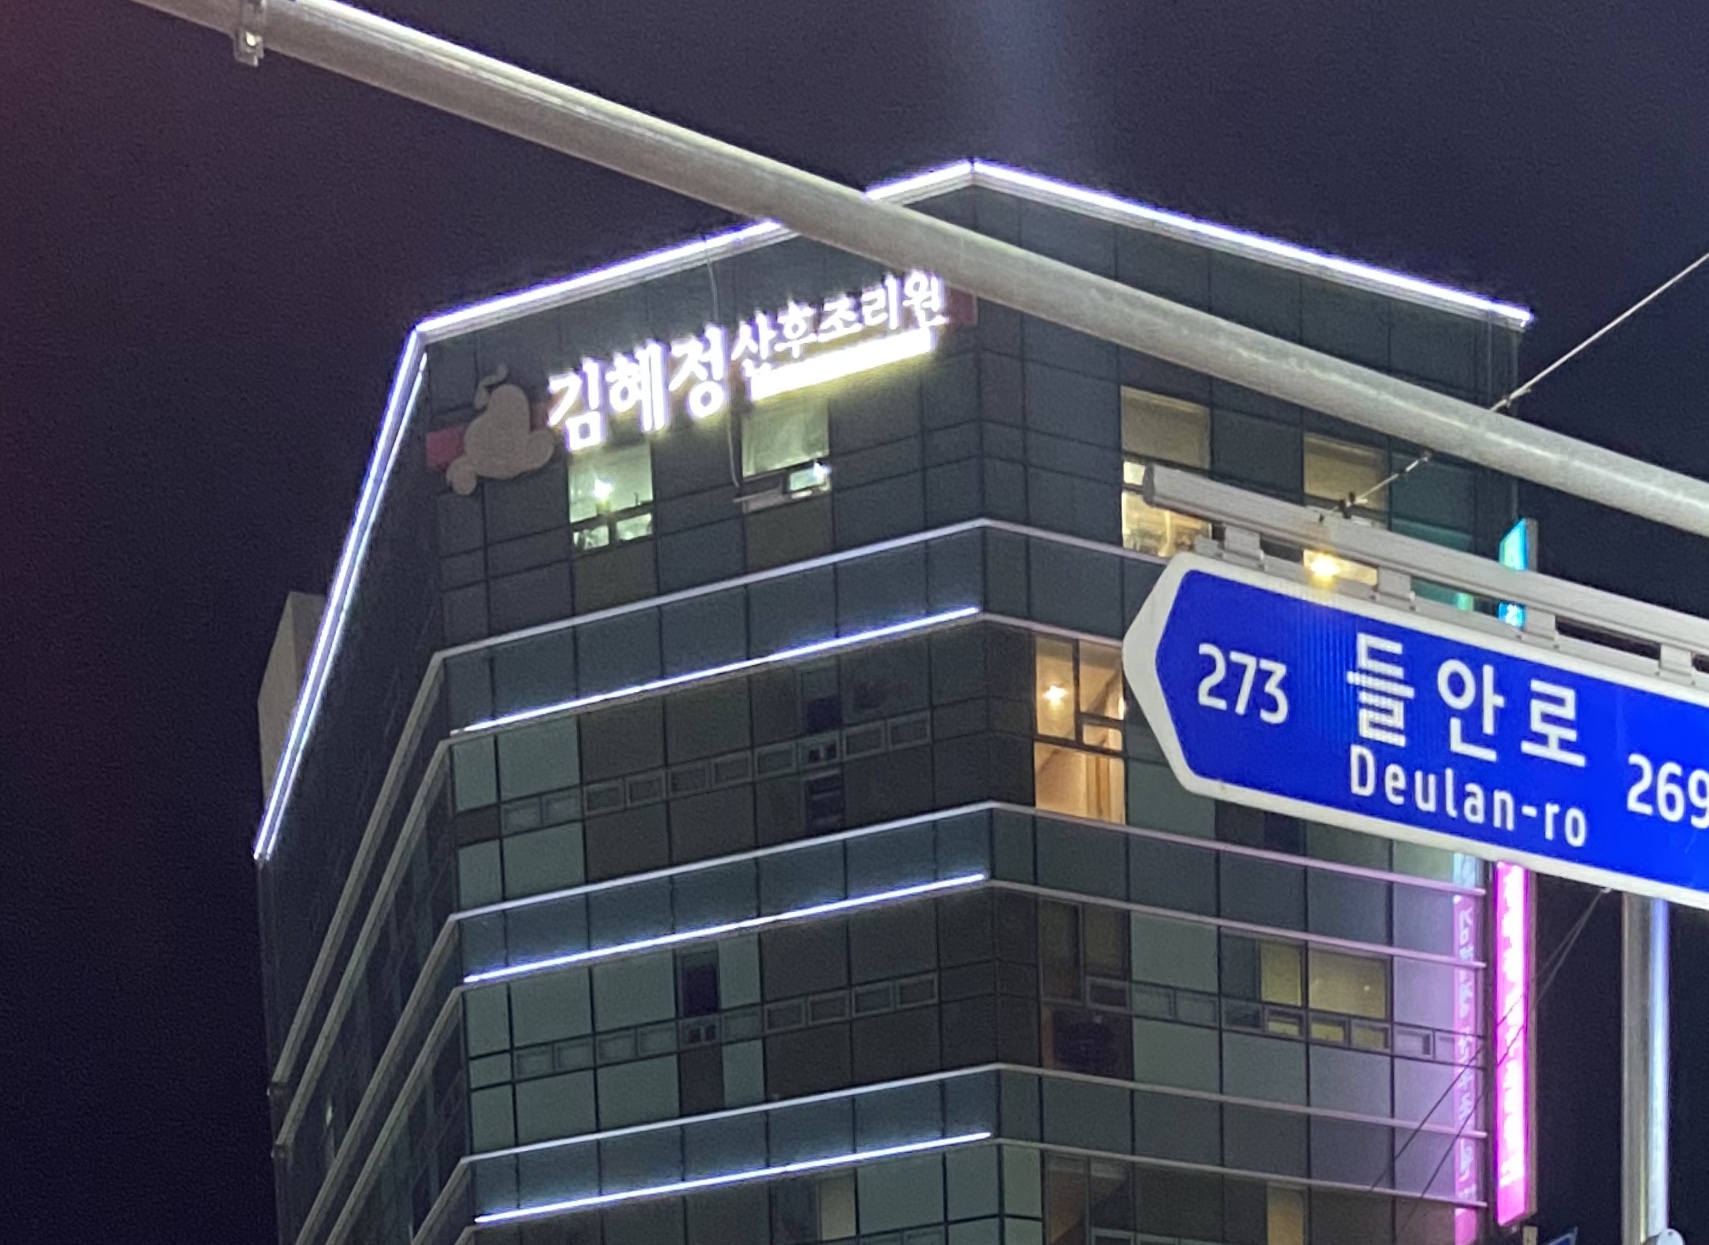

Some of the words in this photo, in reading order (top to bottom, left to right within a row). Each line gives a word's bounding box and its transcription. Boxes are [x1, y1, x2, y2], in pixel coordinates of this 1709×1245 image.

[548, 322, 728, 452] 김혜정
[1198, 643, 1289, 725] 273
[1347, 632, 1586, 767] 들안로
[1349, 743, 1588, 848] Deulan-ro
[1626, 753, 1709, 829] 269
